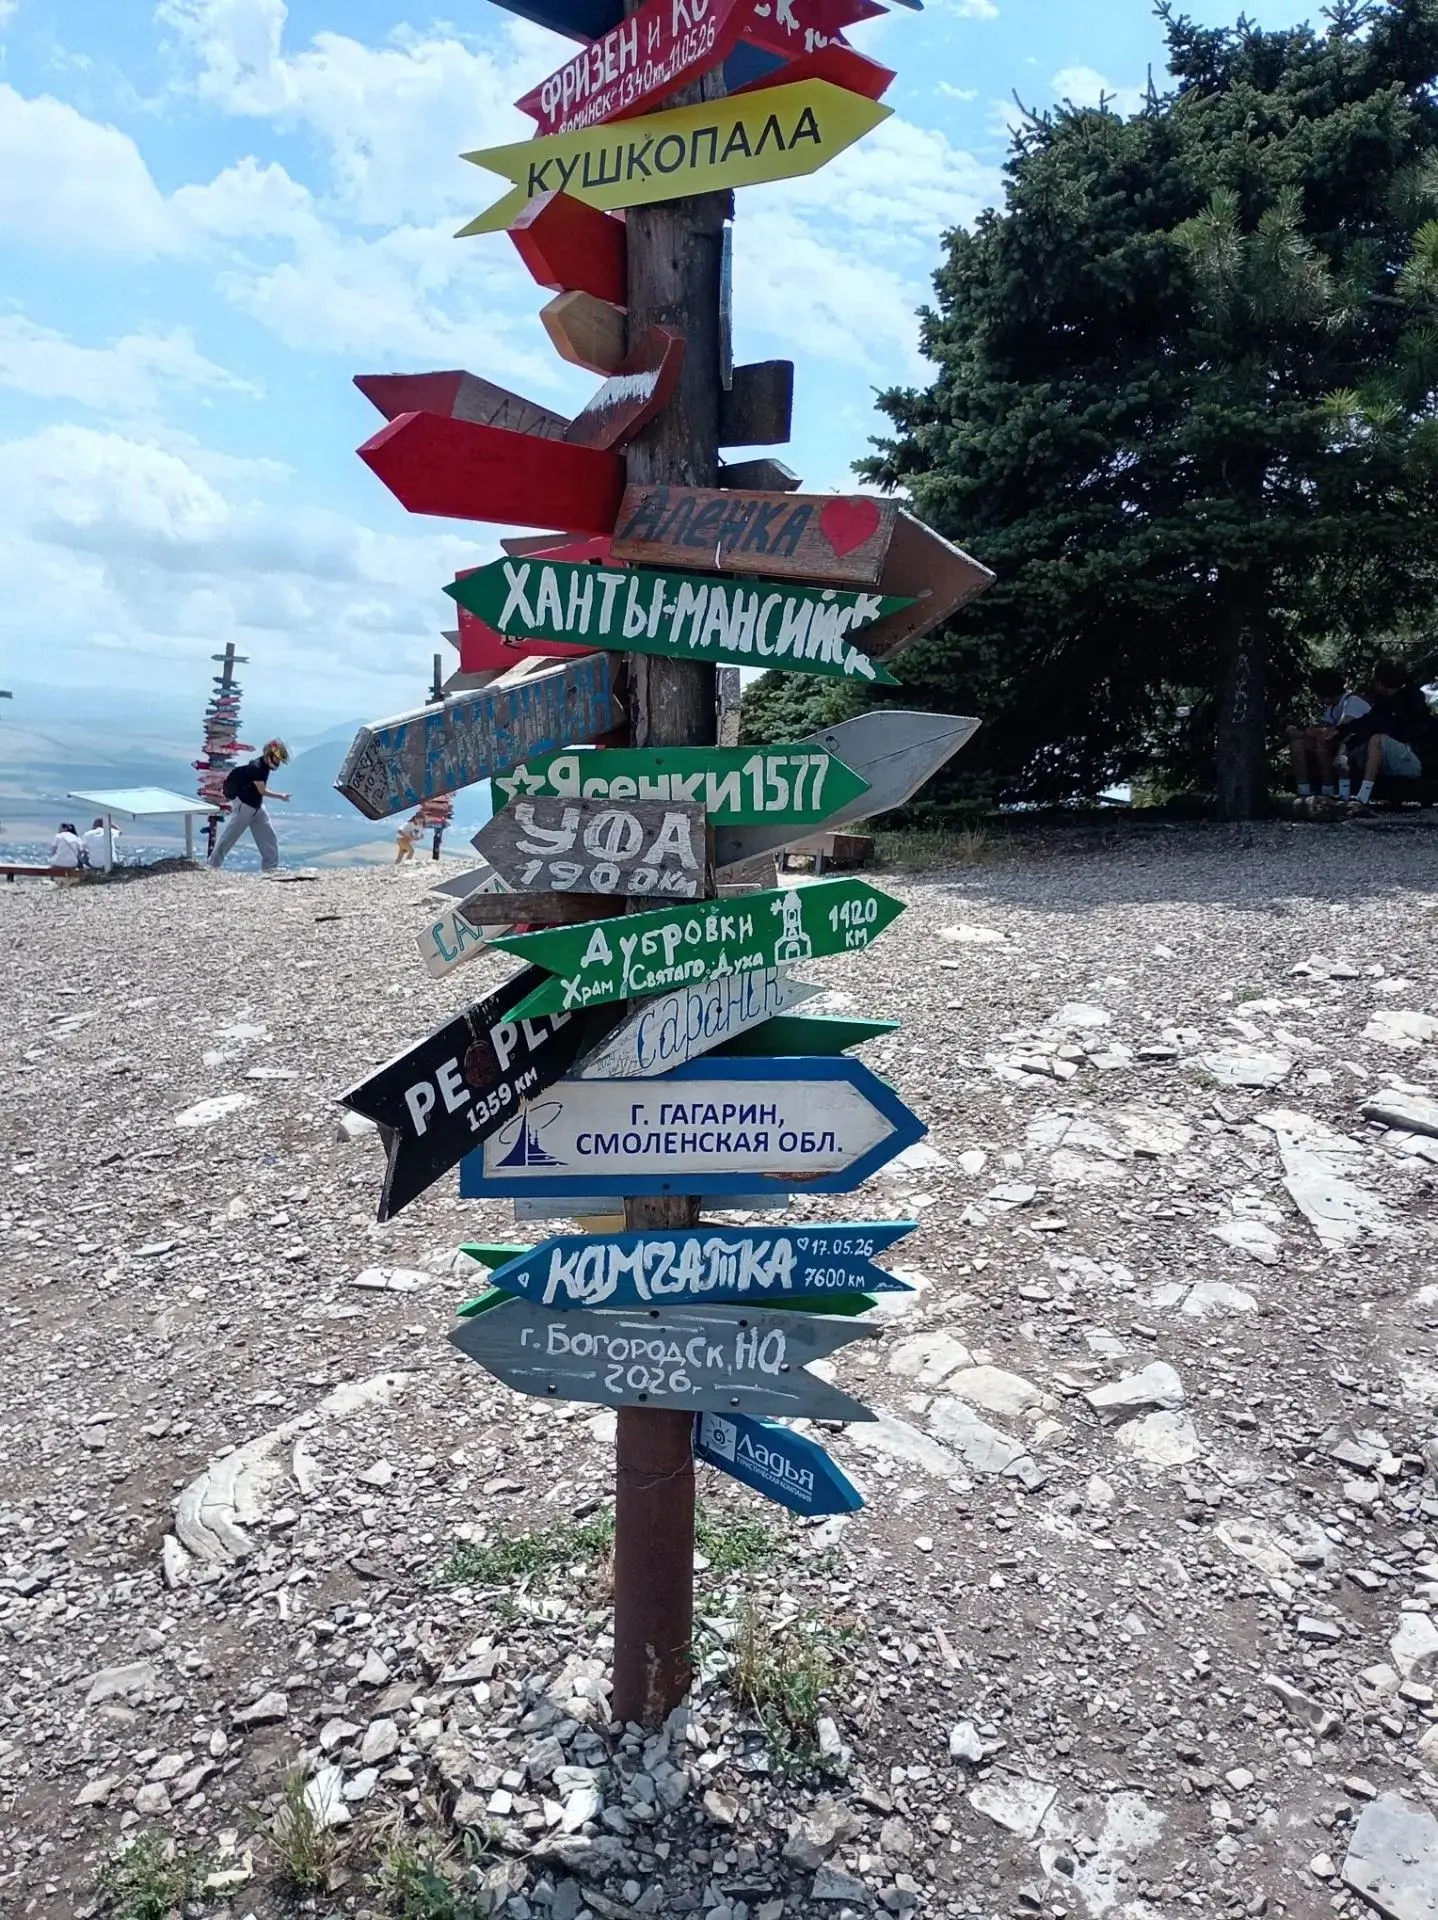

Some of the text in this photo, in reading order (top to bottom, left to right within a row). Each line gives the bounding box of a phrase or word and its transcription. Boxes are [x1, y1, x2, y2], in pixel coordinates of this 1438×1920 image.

[541, 17, 638, 123] ФРИЗЕН
[527, 106, 822, 198] КУШКОПАЛА
[742, 754, 829, 811] 1577
[514, 802, 699, 869] УФА
[829, 898, 878, 932] 1420
[466, 1083, 512, 1132] 1359
[631, 1103, 785, 1129] Г. ГАГАРИН,
[576, 1131, 843, 1155] СМОЛЕНСКАЯ ОБЛ.
[811, 1238, 874, 1256] 17.05.26
[804, 1267, 846, 1288] 7600
[737, 1434, 815, 1491] Ладья
